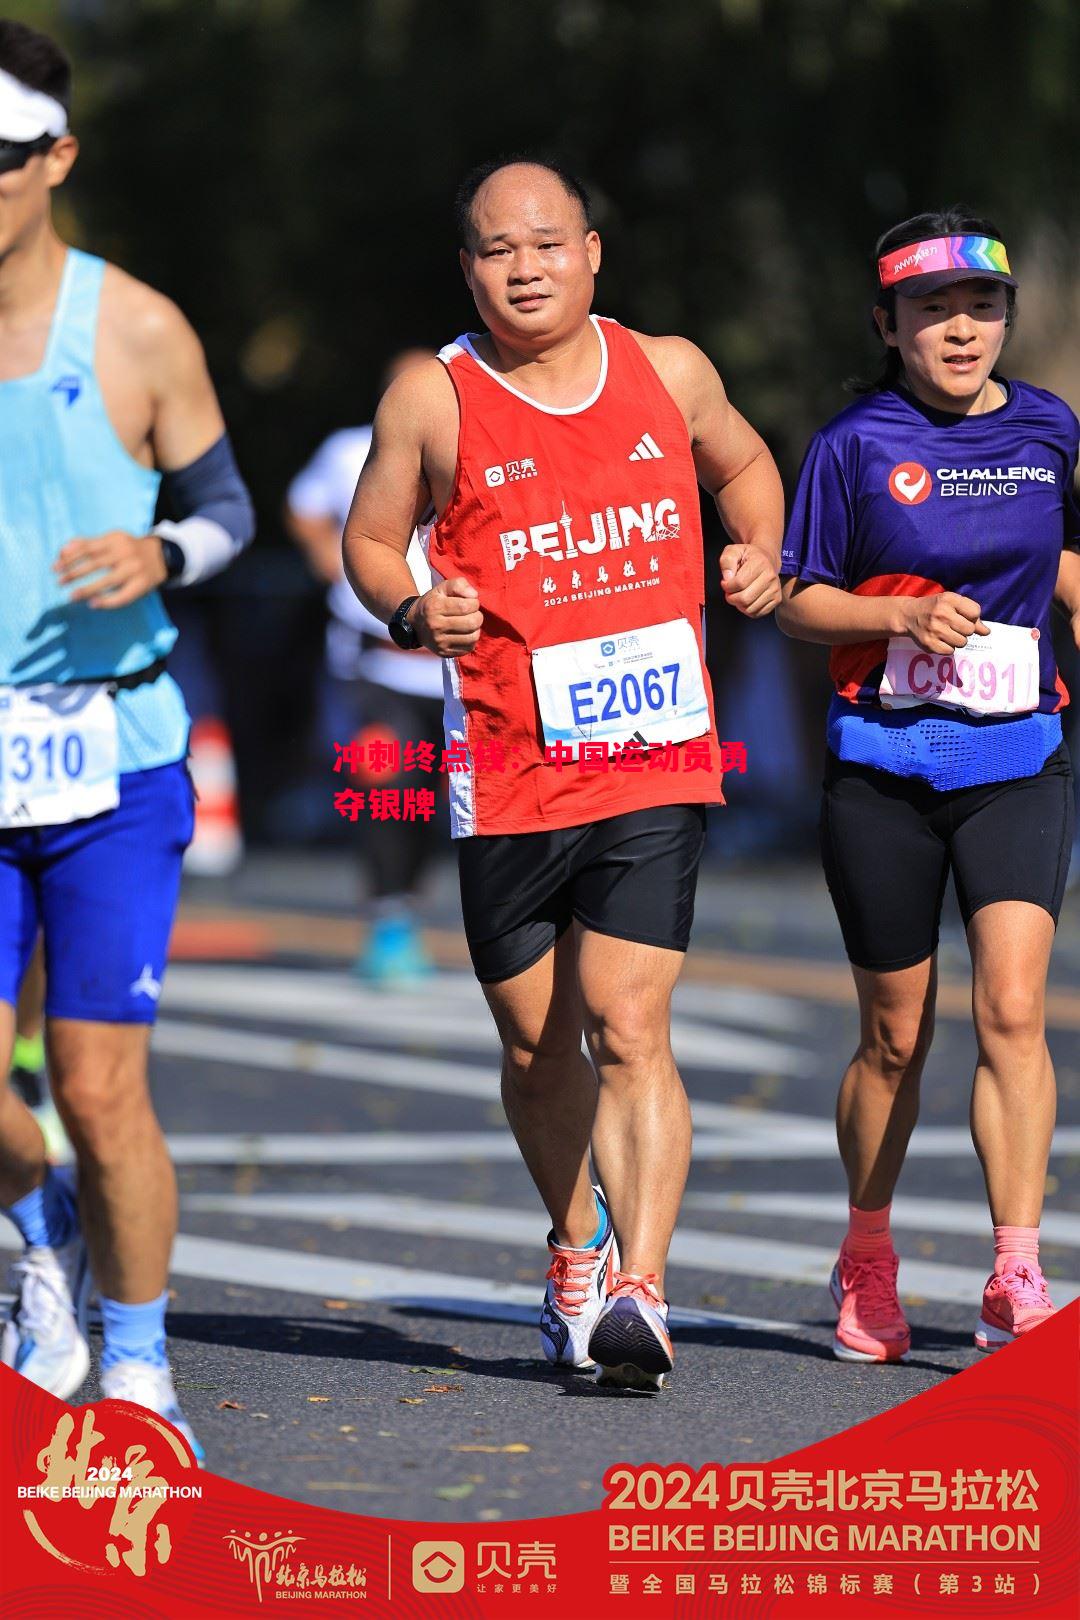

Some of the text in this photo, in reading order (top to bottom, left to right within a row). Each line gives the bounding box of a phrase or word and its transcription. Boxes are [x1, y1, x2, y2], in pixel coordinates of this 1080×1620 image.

[506, 458, 536, 476] 贝壳
[936, 466, 1056, 484] CHALLENGE
[940, 482, 1018, 497] BEIJING
[499, 500, 681, 572] BEIJING
[542, 555, 659, 593] 北京马拉松
[544, 577, 660, 607] 2024 BEIJING MARATHON
[568, 662, 680, 726] E2067
[907, 653, 1015, 704] C9091
[0, 733, 84, 782] 310
